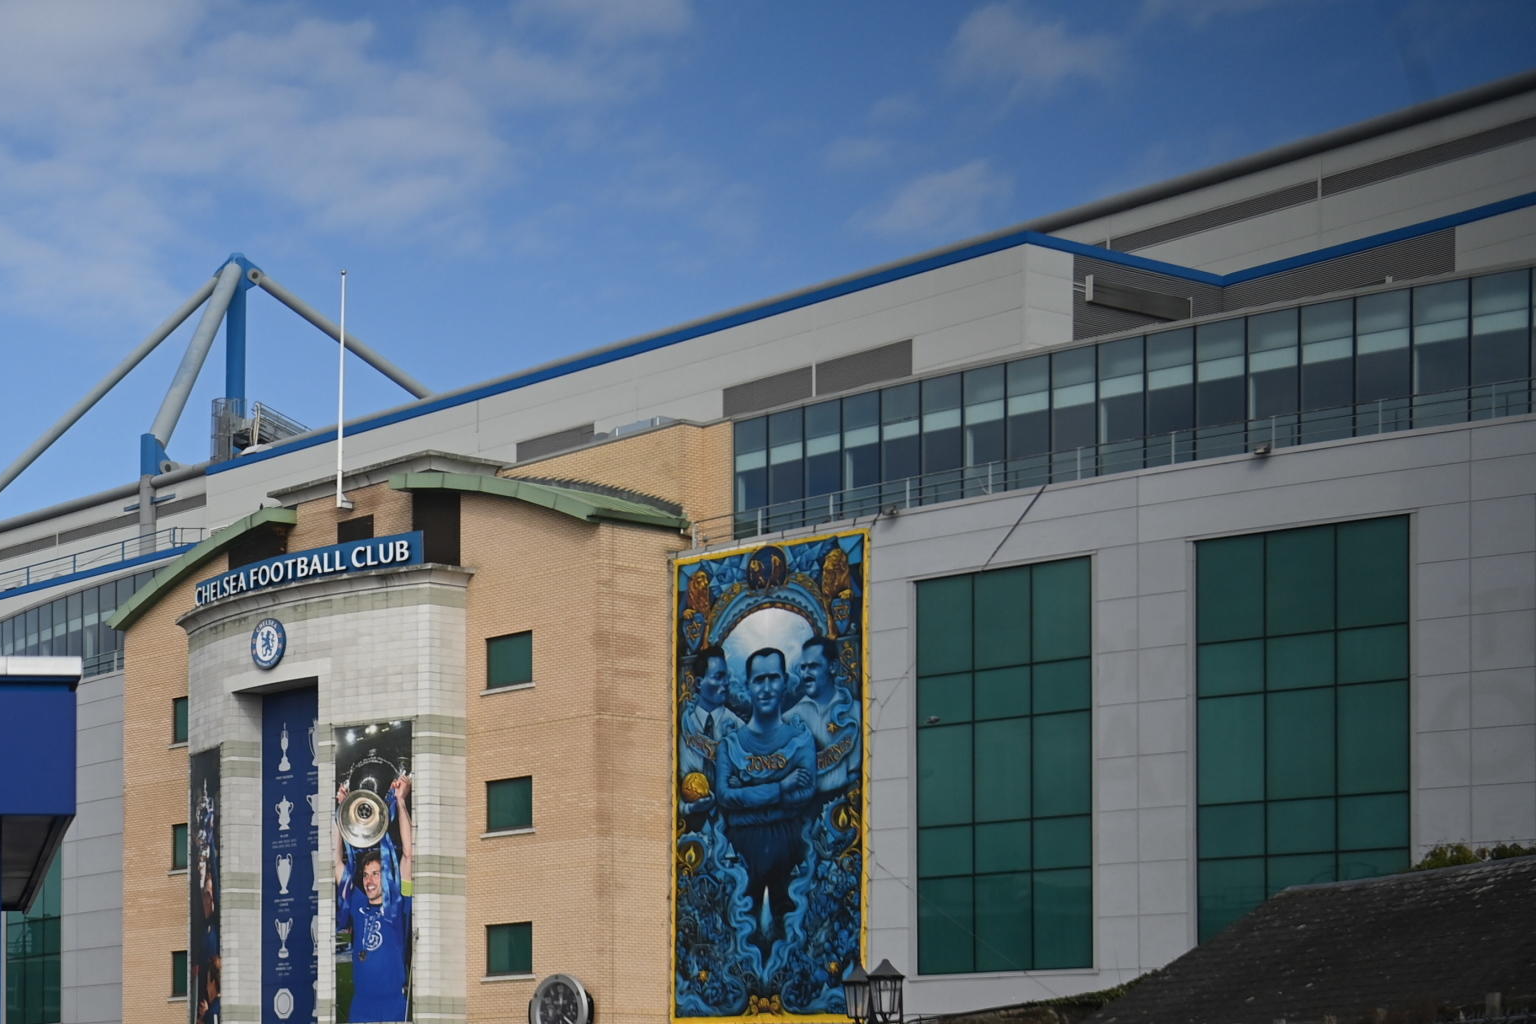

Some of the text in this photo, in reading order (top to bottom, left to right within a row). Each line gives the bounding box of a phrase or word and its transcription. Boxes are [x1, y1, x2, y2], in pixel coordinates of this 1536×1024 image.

[194, 540, 410, 607] CHELSEA FOOTBALL CLUB
